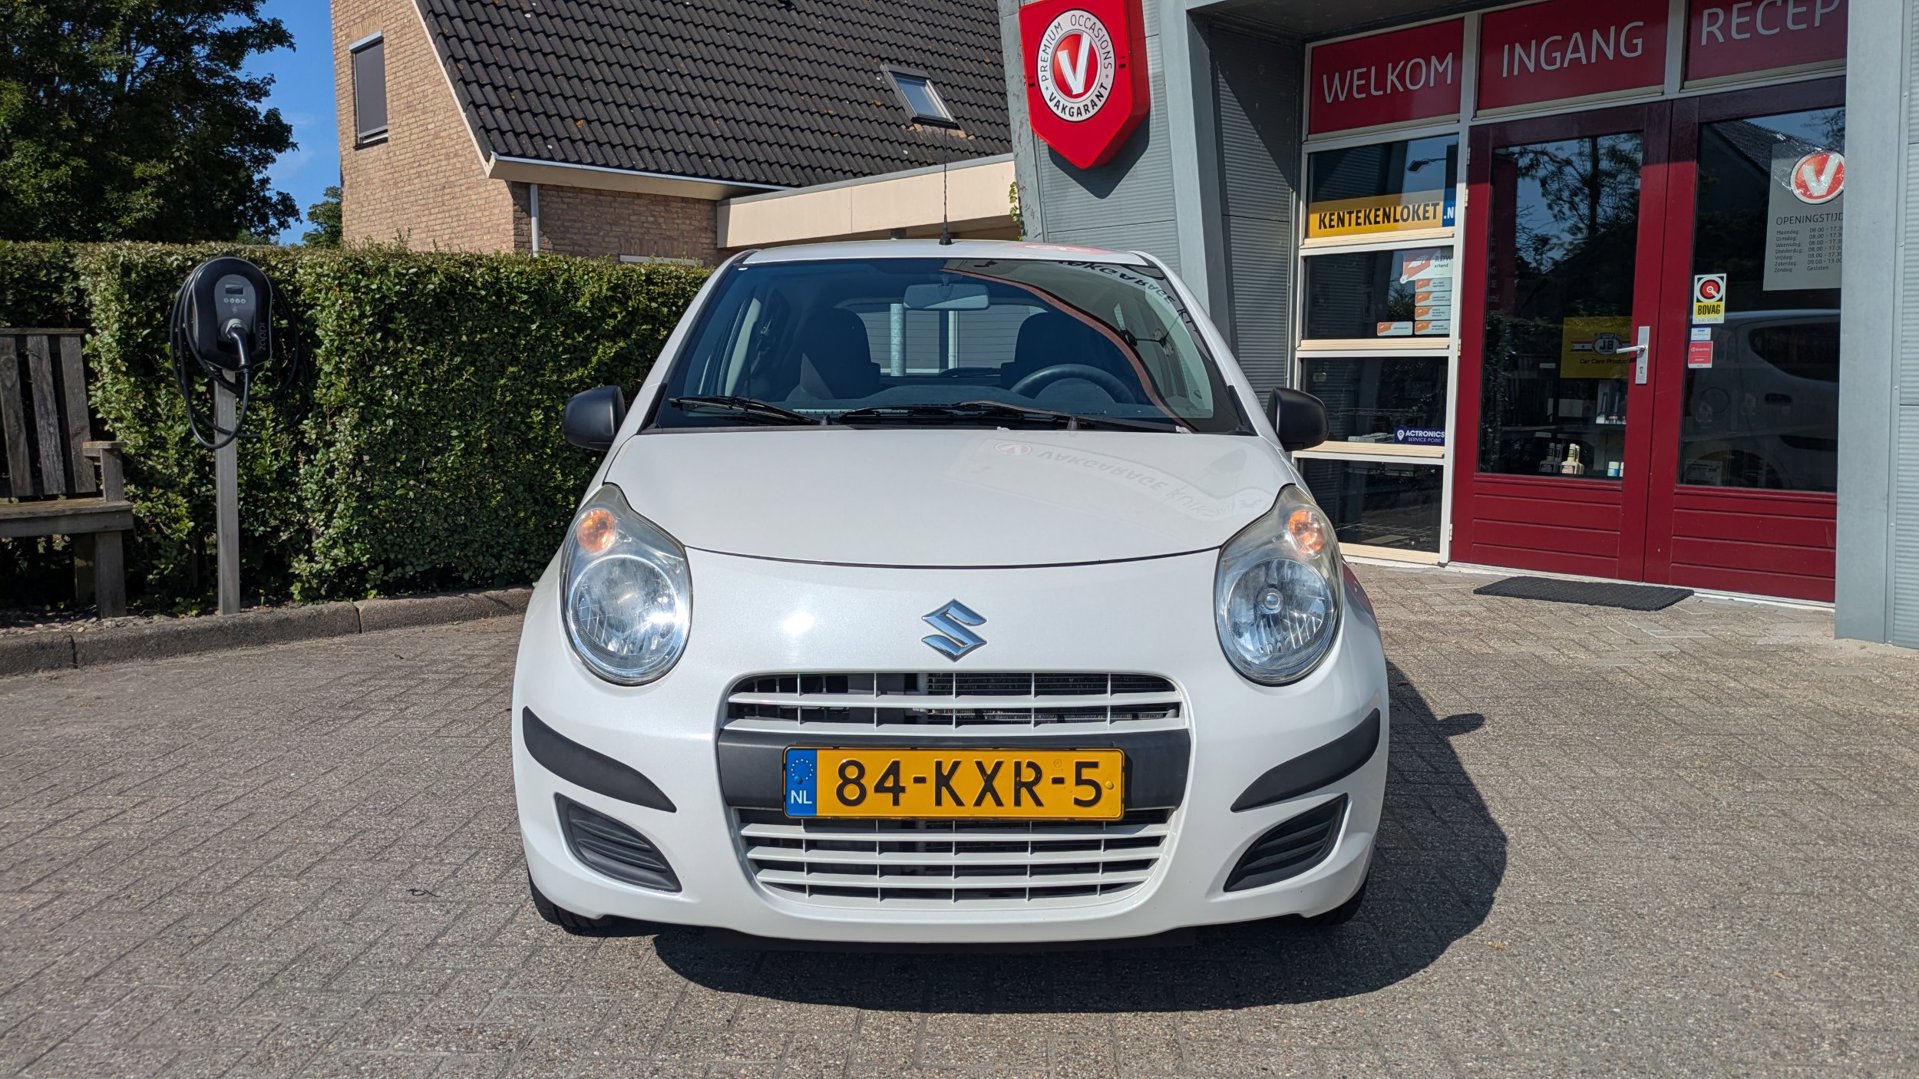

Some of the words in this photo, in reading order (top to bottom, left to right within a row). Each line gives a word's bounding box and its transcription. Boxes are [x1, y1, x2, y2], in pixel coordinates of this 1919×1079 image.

[1041, 22, 1064, 83] PREMIUM
[1070, 13, 1113, 70] OCCASIONS
[1502, 20, 1644, 78] INGANG
[1323, 52, 1453, 104] WELKOM
[1048, 83, 1109, 118] VAKGARANT
[1697, 304, 1721, 315] BOVAG
[1405, 430, 1445, 438] ACTRONICS
[791, 790, 812, 804] NL
[835, 759, 1103, 807] 84-KXR-5
